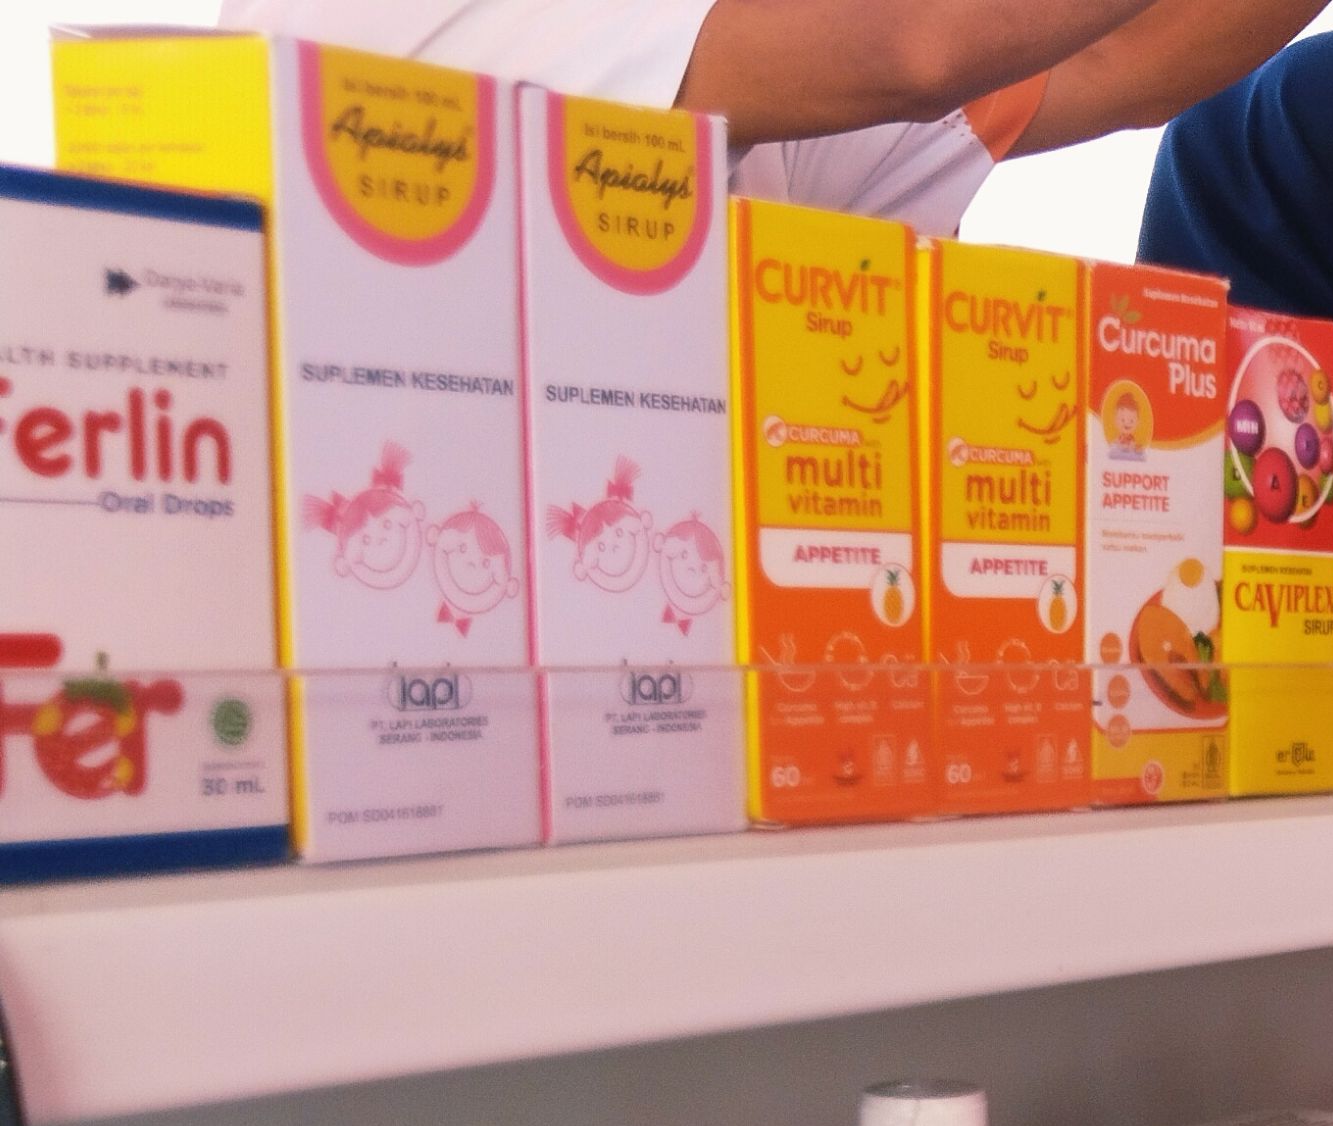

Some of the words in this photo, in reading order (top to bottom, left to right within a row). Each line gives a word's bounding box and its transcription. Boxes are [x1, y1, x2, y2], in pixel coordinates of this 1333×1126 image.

[331, 105, 471, 164] Apialys
[359, 175, 452, 209] SIRUP
[574, 147, 694, 210] Apialys
[597, 211, 676, 242] SIRUP
[755, 257, 893, 316] CURVIT
[806, 311, 853, 339] Sirup
[945, 291, 1066, 344] CURVIT
[987, 340, 1030, 365] Sirup
[1098, 316, 1216, 365] Curcuma
[68, 351, 229, 381] SUPPLEMENT
[301, 362, 407, 391] SUPLEMEN
[410, 369, 516, 399] KESEHATAN
[1168, 361, 1217, 400] Plus
[545, 383, 637, 410] SUPLEMEN
[638, 390, 728, 418] KESEHATAN
[787, 428, 861, 446] CURCUMA
[785, 451, 883, 490] multi
[968, 448, 1034, 465] CURCUMA
[966, 470, 1051, 507] multi
[1102, 470, 1170, 492] SUPPORT
[165, 492, 236, 520] Drops
[787, 491, 884, 518] vitamin
[1102, 492, 1170, 513] APPETITE
[966, 506, 1051, 533] vitamin
[793, 544, 881, 566] APPETITE
[969, 557, 1049, 577] APPETITE
[771, 766, 801, 788] 60
[945, 763, 972, 785] 60
